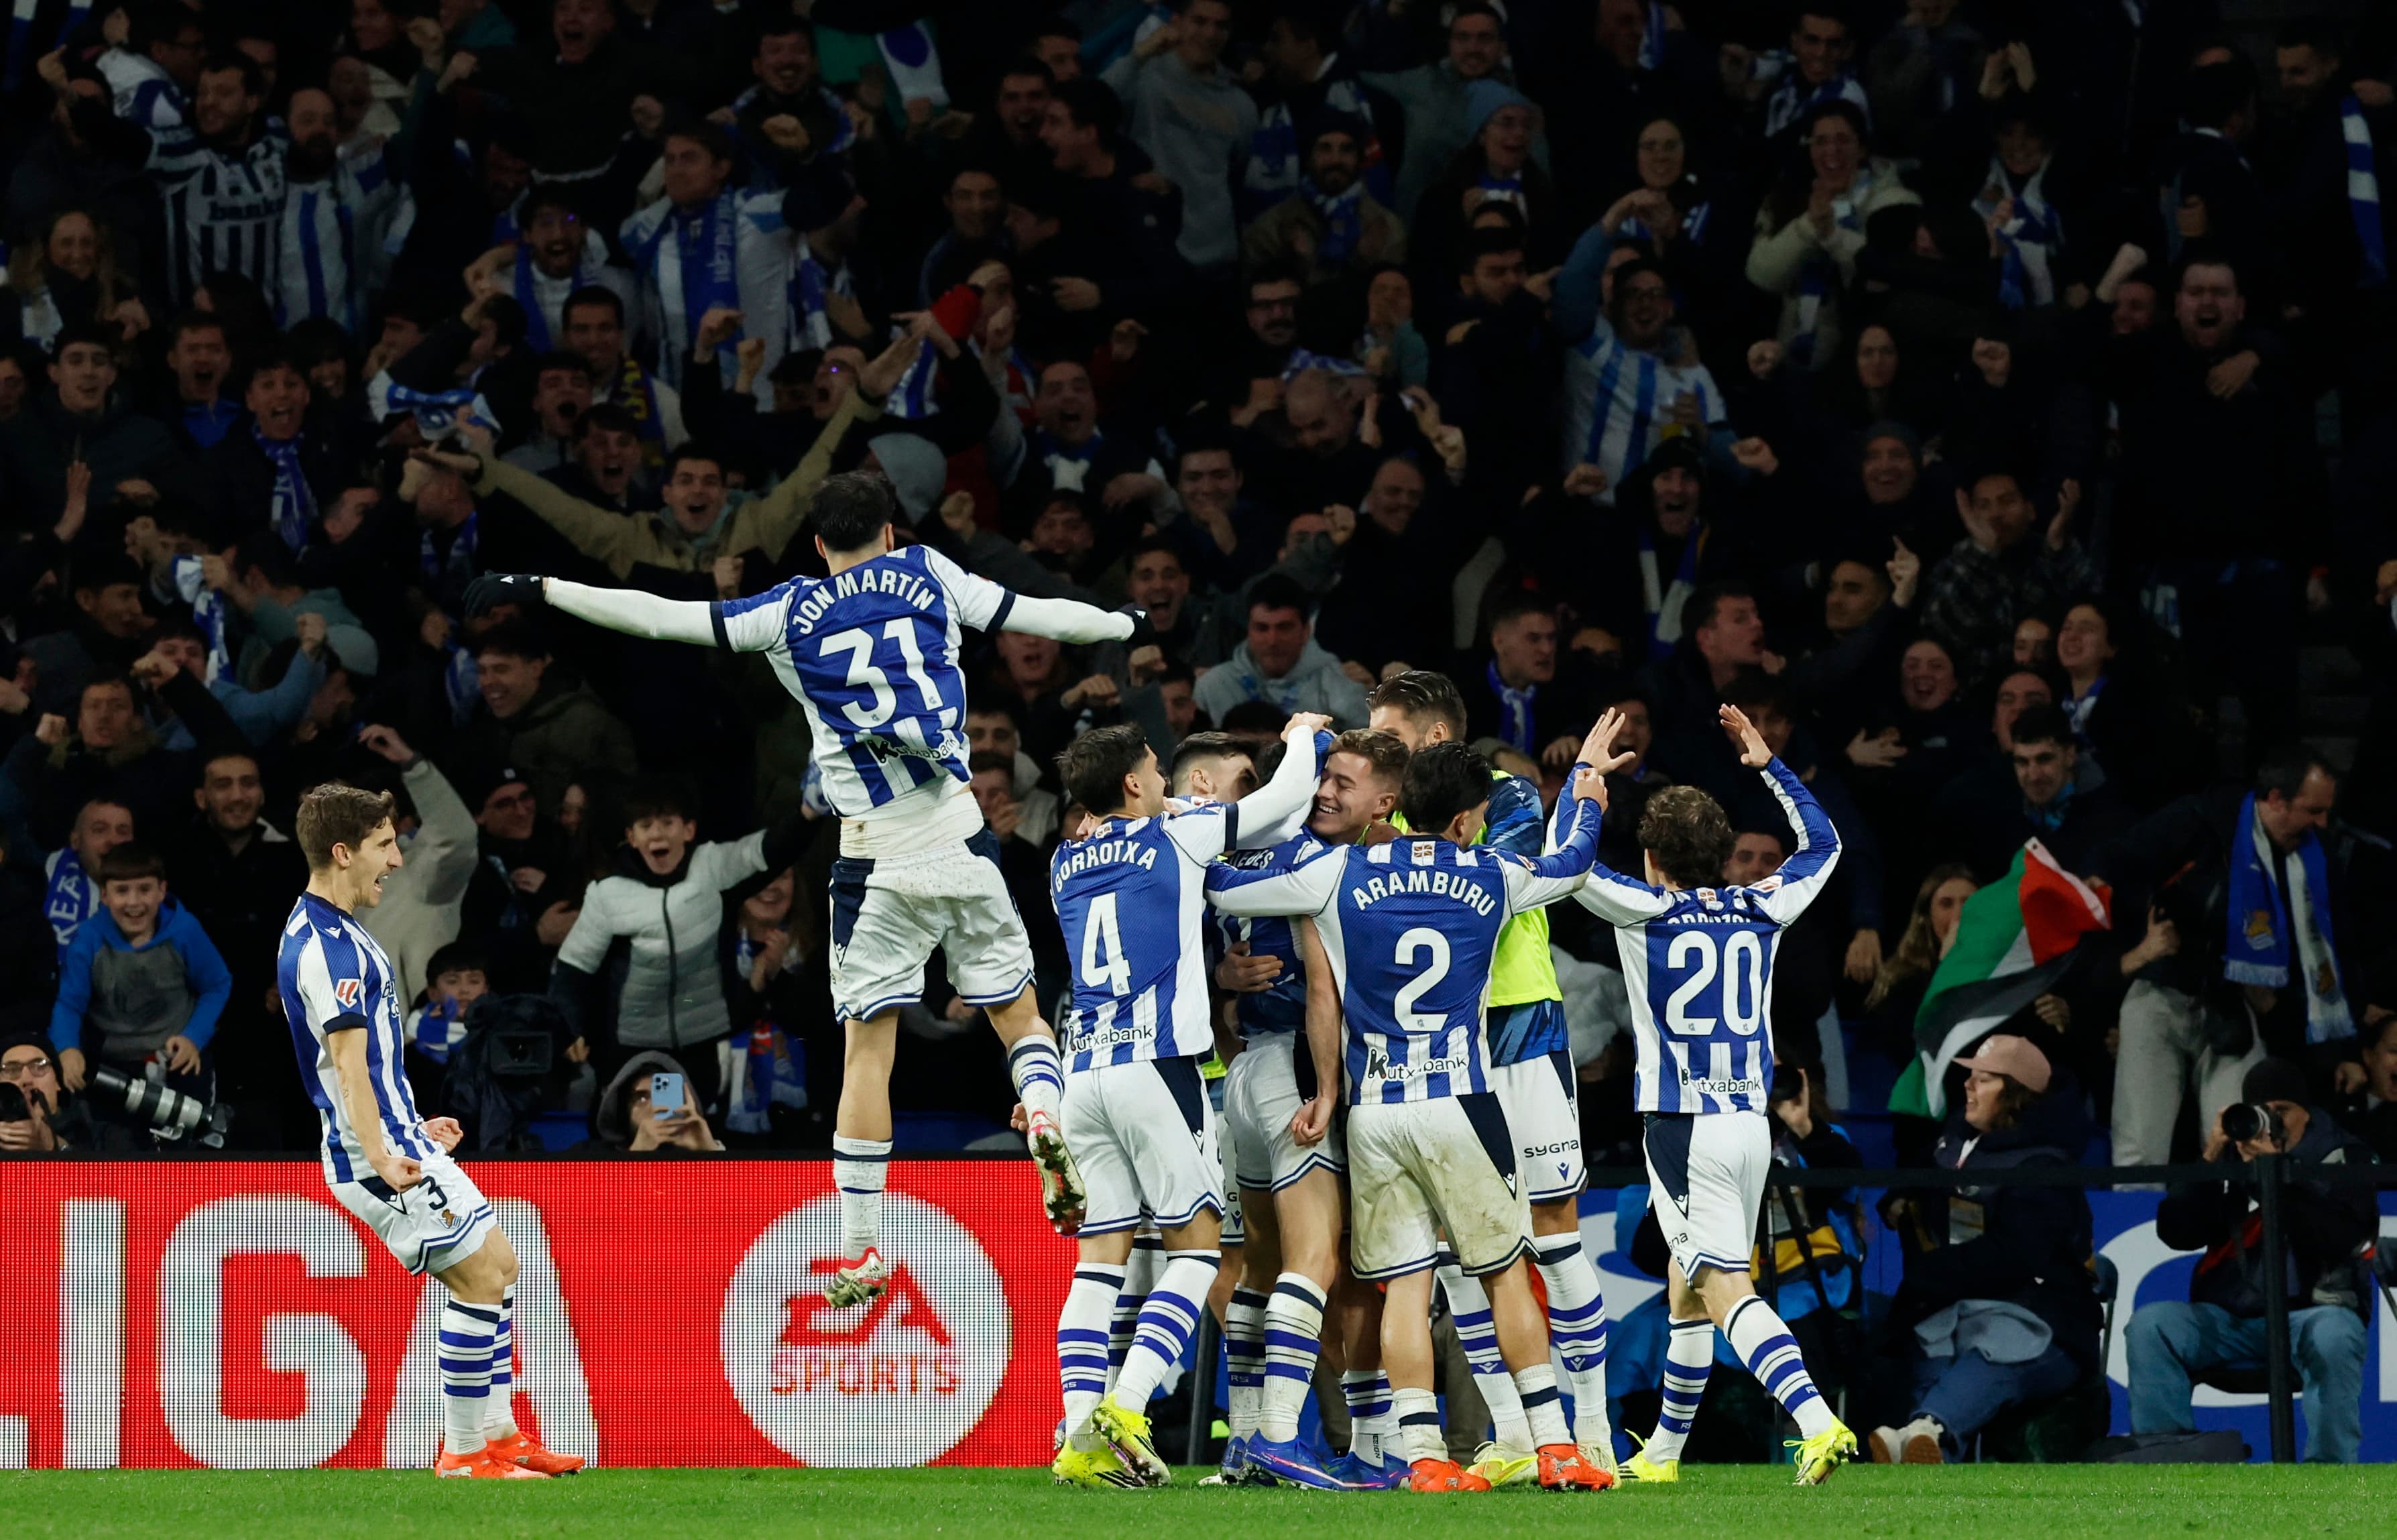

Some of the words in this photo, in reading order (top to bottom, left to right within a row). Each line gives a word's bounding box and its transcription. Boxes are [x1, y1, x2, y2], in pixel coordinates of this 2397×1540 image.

[792, 584, 835, 635] JON
[835, 568, 936, 611] MARTÍN
[818, 616, 944, 728] 31
[1055, 839, 1158, 893] GORROTXA
[1352, 870, 1497, 916] ARAMBURU
[1081, 891, 1132, 998] 4
[1394, 927, 1452, 1032] 2
[1665, 929, 1763, 1036] 20
[418, 1175, 448, 1211] 3
[771, 1353, 959, 1395] SPORTS
